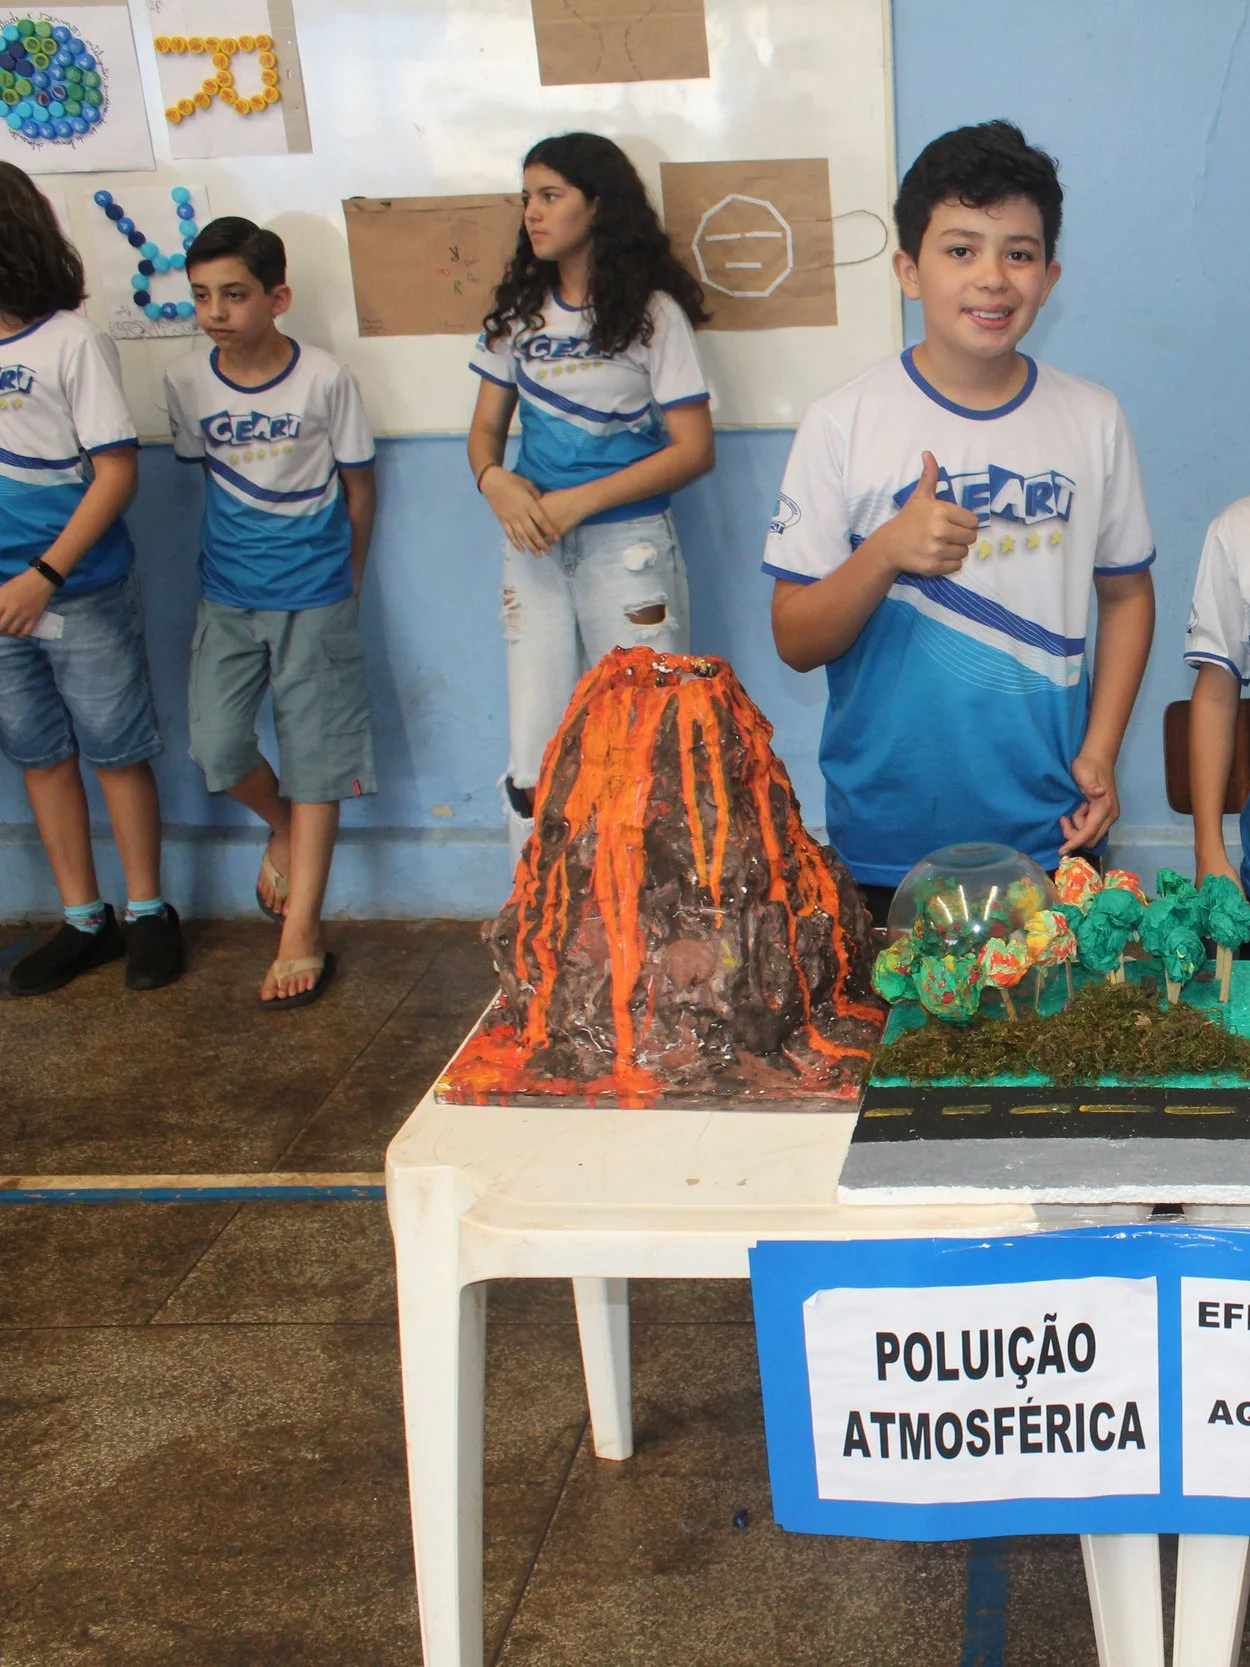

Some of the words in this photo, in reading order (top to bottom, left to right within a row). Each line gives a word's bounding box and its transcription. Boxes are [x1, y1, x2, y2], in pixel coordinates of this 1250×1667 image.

[522, 335, 613, 362] CEA
[201, 411, 302, 446] CEART
[875, 1312, 1096, 1389] POLUIÇÃO
[842, 1396, 1146, 1460] ATMOSFÉRICA
